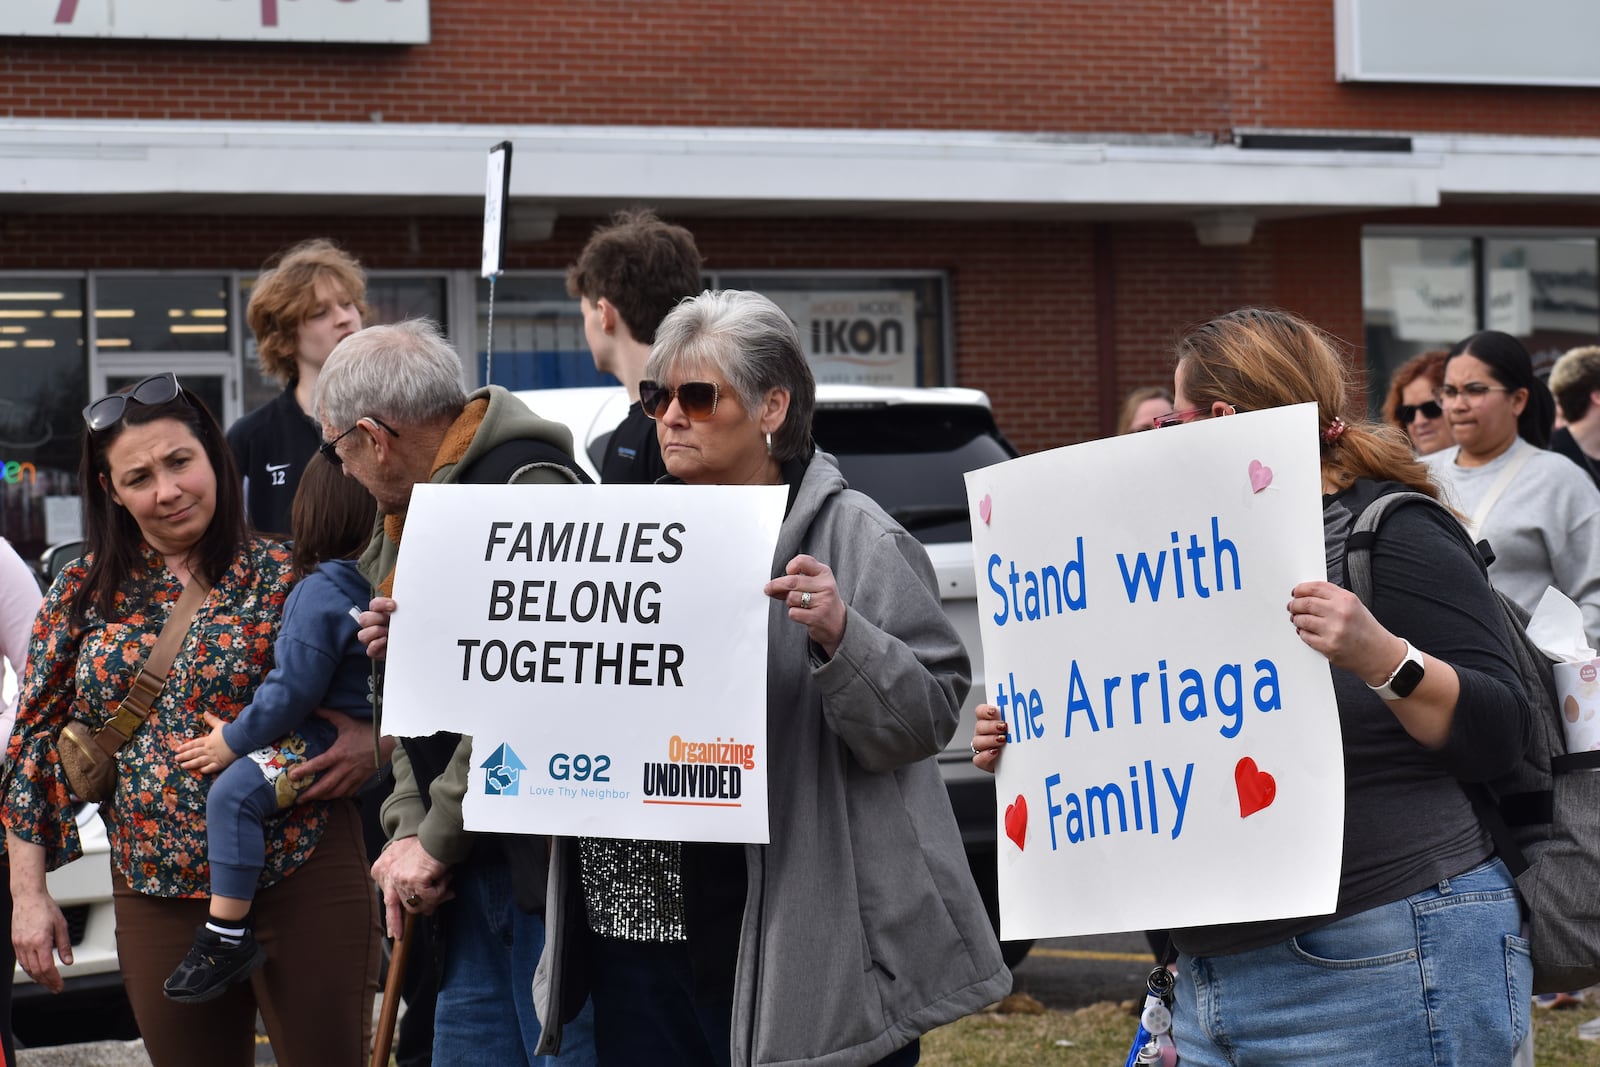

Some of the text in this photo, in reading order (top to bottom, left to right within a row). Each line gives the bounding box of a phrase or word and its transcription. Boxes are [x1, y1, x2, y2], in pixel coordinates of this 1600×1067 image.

[272, 470, 285, 486] 12
[484, 522, 686, 564] FAMILIES
[987, 517, 1242, 627] Stand with
[488, 580, 662, 625] BELONG
[457, 639, 685, 687] TOGETHER
[996, 658, 1282, 744] the Arriaga
[548, 753, 611, 783] G92
[668, 735, 755, 770] Organizing
[529, 786, 631, 801] Love Thy Neighbor
[643, 762, 742, 799] UNDIVIDED
[1045, 760, 1195, 851] Family
